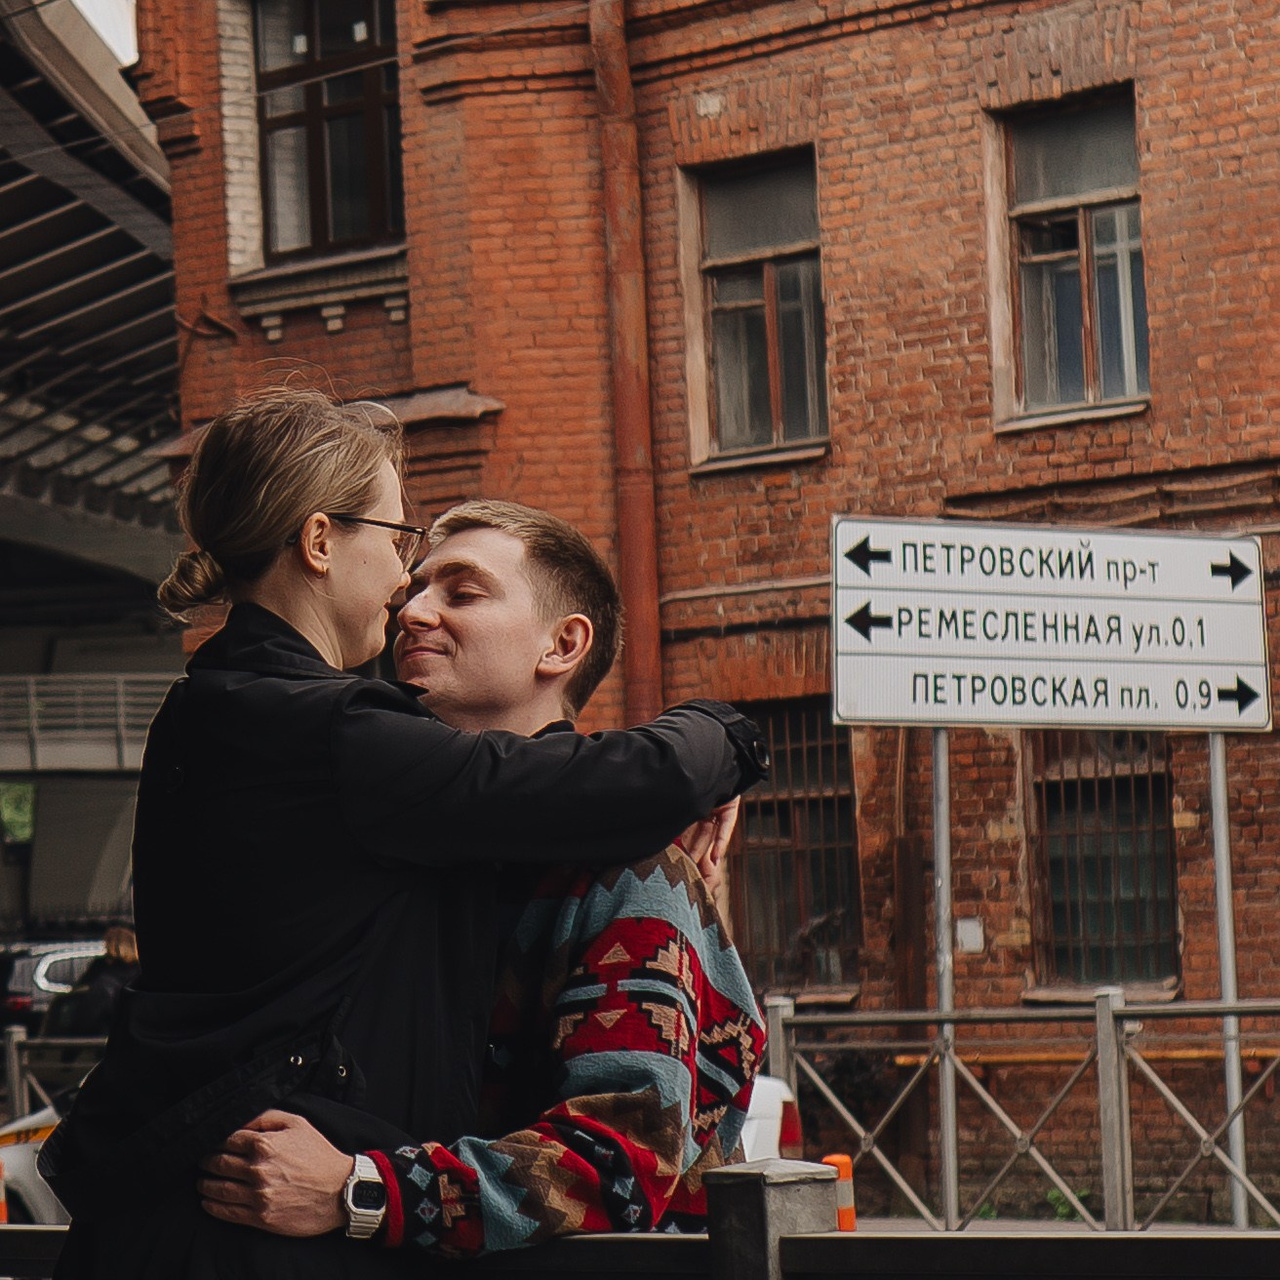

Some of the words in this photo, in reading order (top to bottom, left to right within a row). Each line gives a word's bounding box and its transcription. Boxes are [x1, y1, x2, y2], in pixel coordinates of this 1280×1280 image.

[901, 538, 1095, 581] ПЕТРОВСКИЙ
[1106, 558, 1159, 591] пр-т
[897, 606, 1122, 646] РЕМЕСЛЕННАЯ
[912, 673, 1109, 708] ПЕТРОВСКАЯ
[1120, 685, 1159, 709] пл.
[1175, 678, 1212, 713] 0,9
